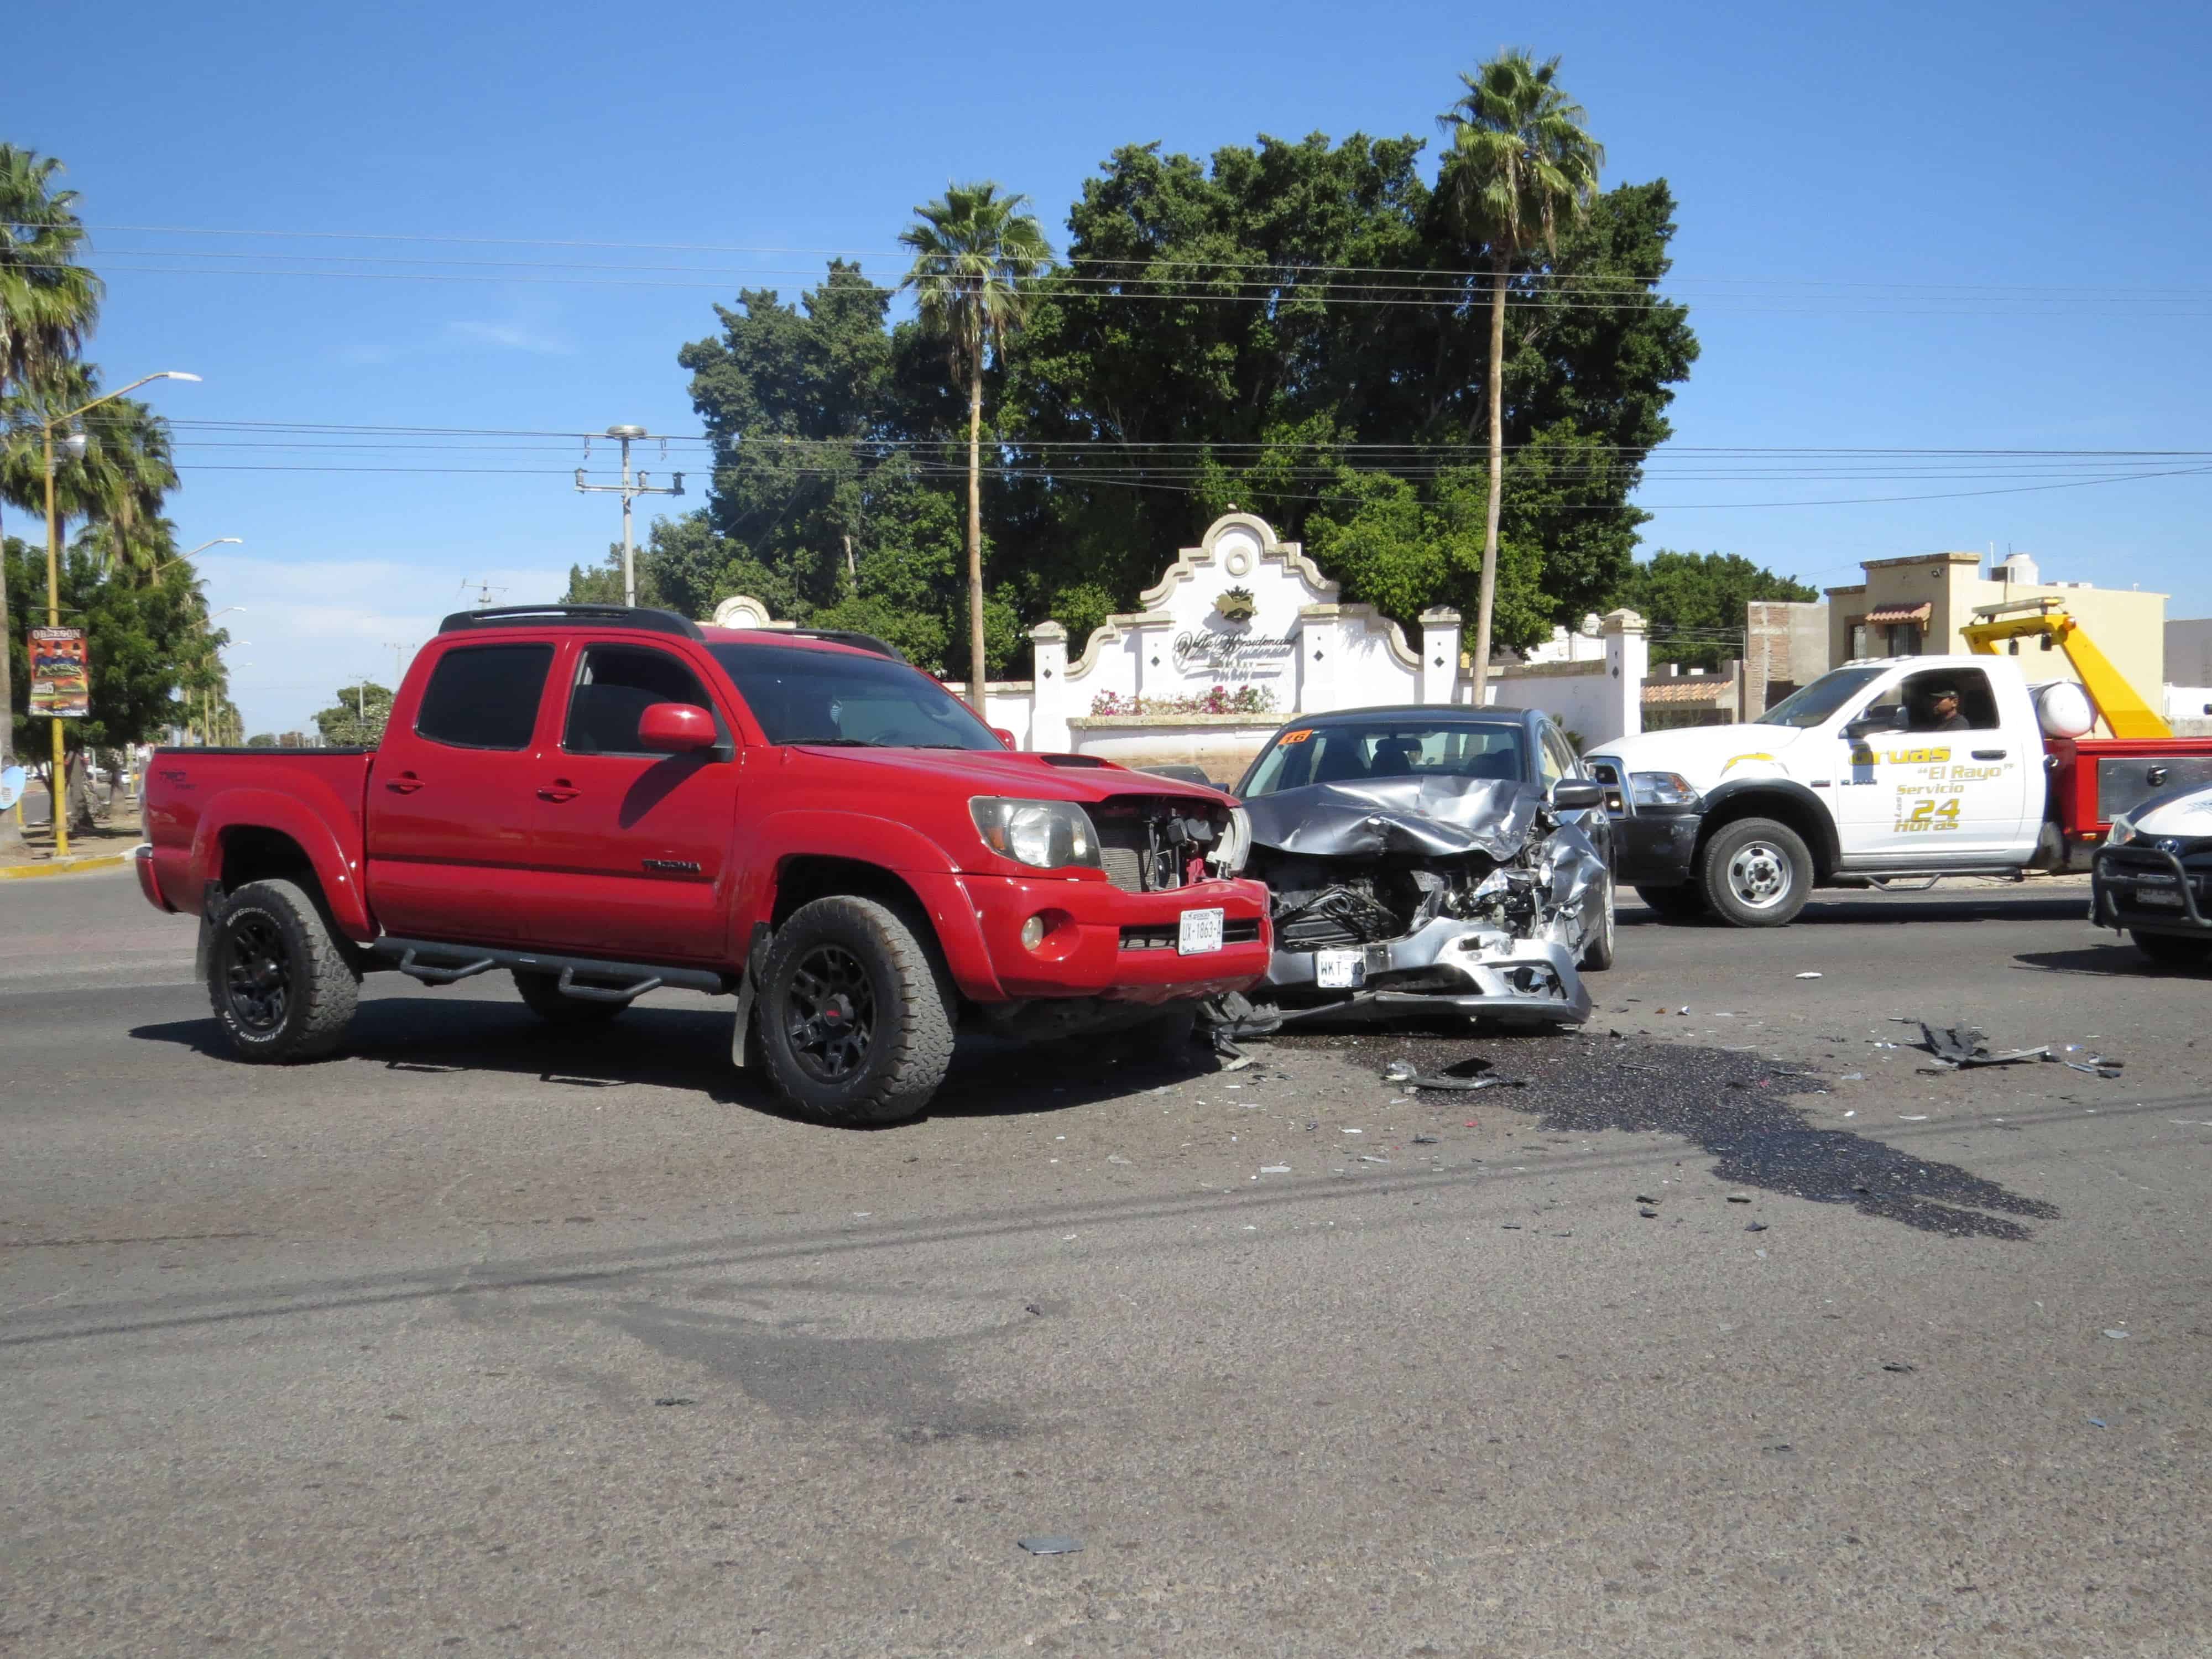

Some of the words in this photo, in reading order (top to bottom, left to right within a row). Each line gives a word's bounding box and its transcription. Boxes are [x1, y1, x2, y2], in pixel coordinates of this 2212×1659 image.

[1896, 782, 1965, 795] Servicio
[1911, 799, 1961, 822] 24
[1893, 819, 1959, 832] Horas
